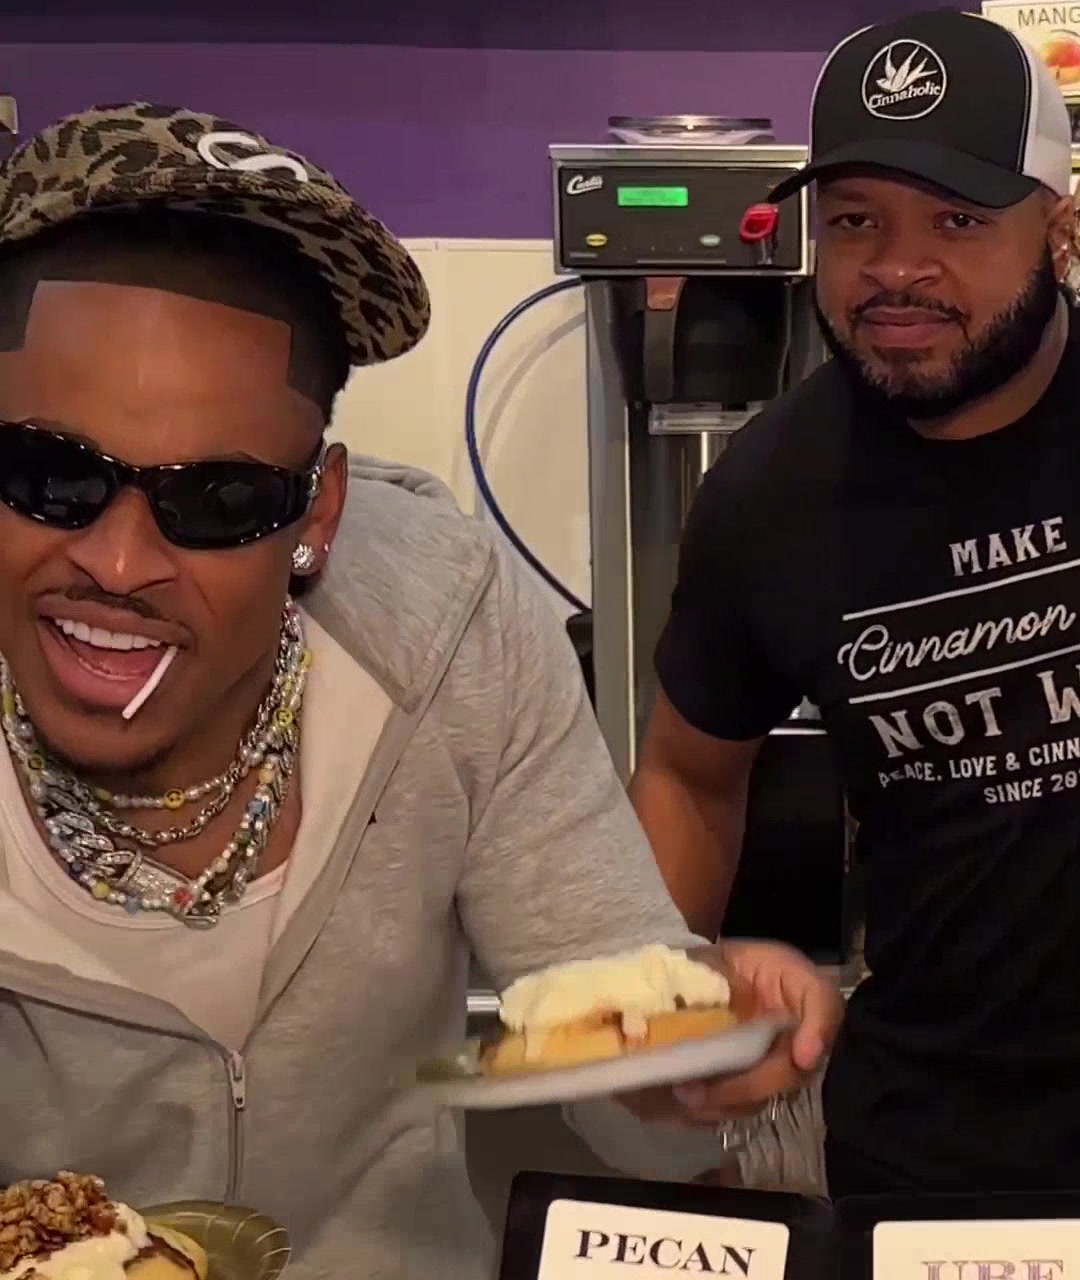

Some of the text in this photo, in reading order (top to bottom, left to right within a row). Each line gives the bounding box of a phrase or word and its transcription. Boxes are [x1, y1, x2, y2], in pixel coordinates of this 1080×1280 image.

[868, 80, 941, 109] Cinnaholic
[949, 516, 1067, 577] MAKE
[837, 603, 1075, 681] Cinnamon
[869, 687, 1003, 759] NOT
[950, 755, 997, 779] LOVE
[984, 778, 1043, 804] SINCE
[574, 1229, 756, 1278] PECAN
